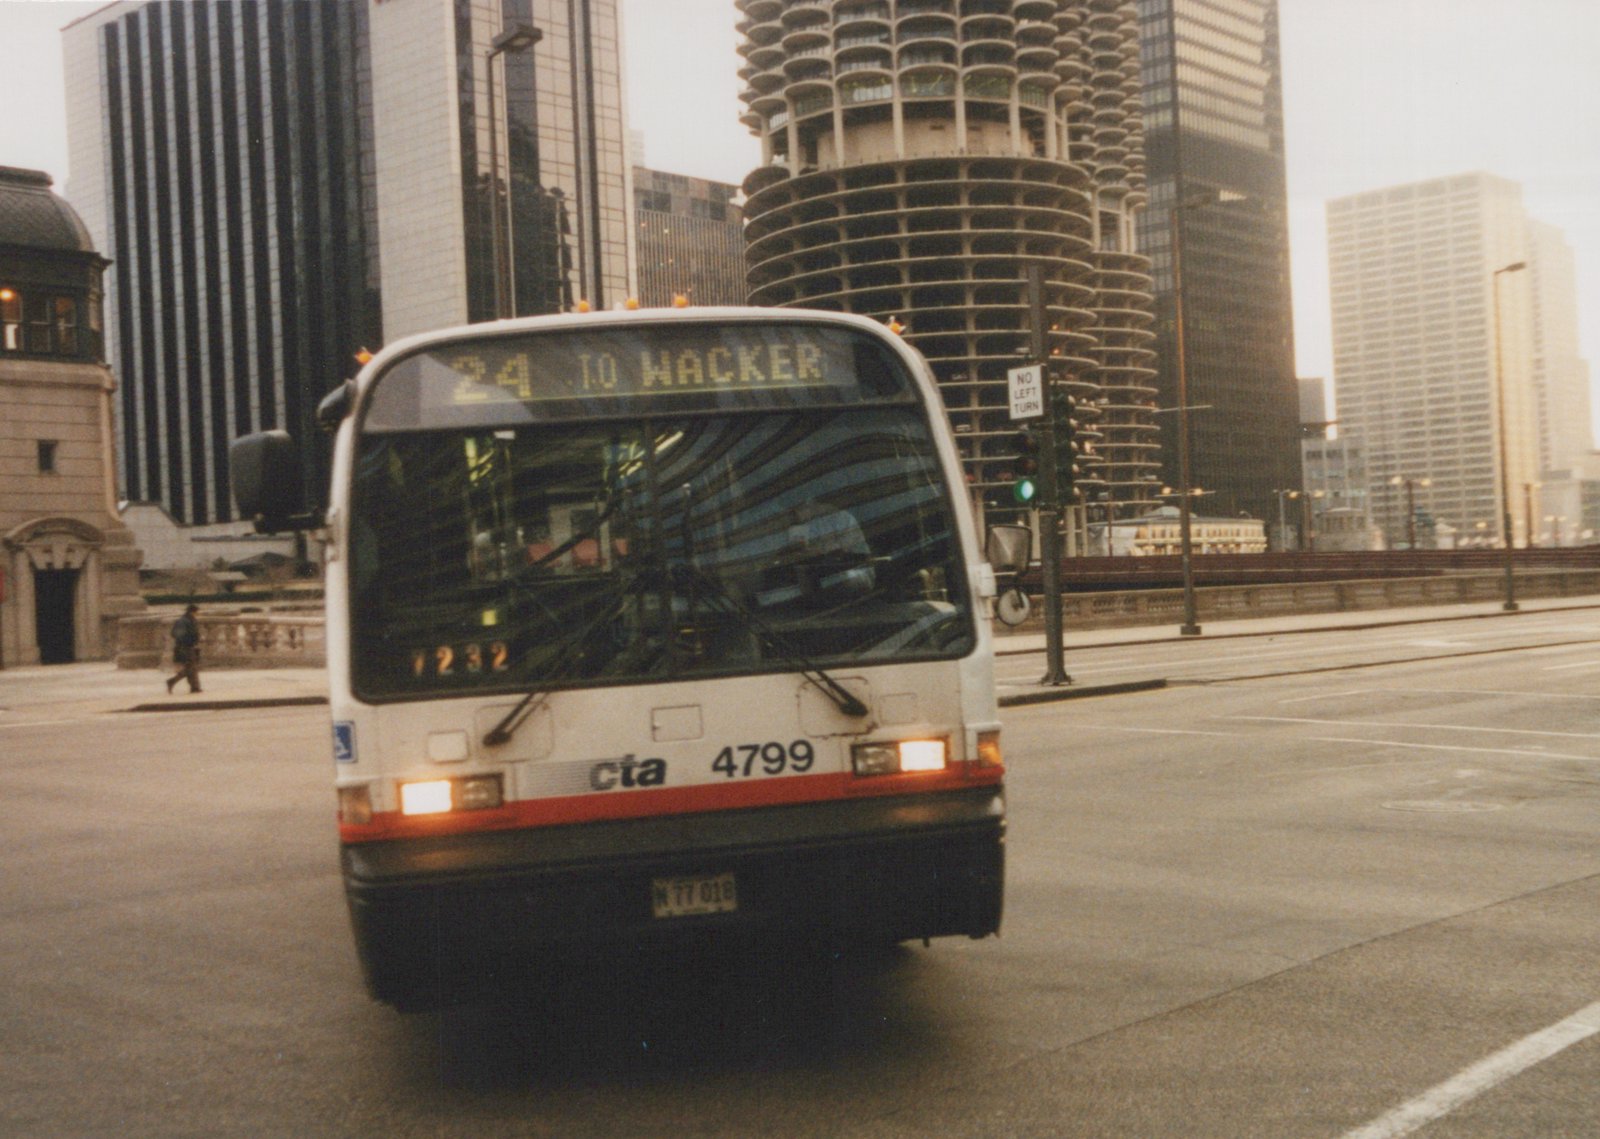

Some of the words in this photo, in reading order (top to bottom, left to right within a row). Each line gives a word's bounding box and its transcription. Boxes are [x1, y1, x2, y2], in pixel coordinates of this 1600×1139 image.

[452, 353, 531, 401] 24
[578, 352, 618, 390] TO
[641, 343, 824, 387] WACKER
[1017, 372, 1032, 385] NO
[1014, 387, 1036, 400] LEFT
[1014, 401, 1039, 413] TURN
[712, 739, 815, 778] 4799
[590, 754, 667, 791] cta
